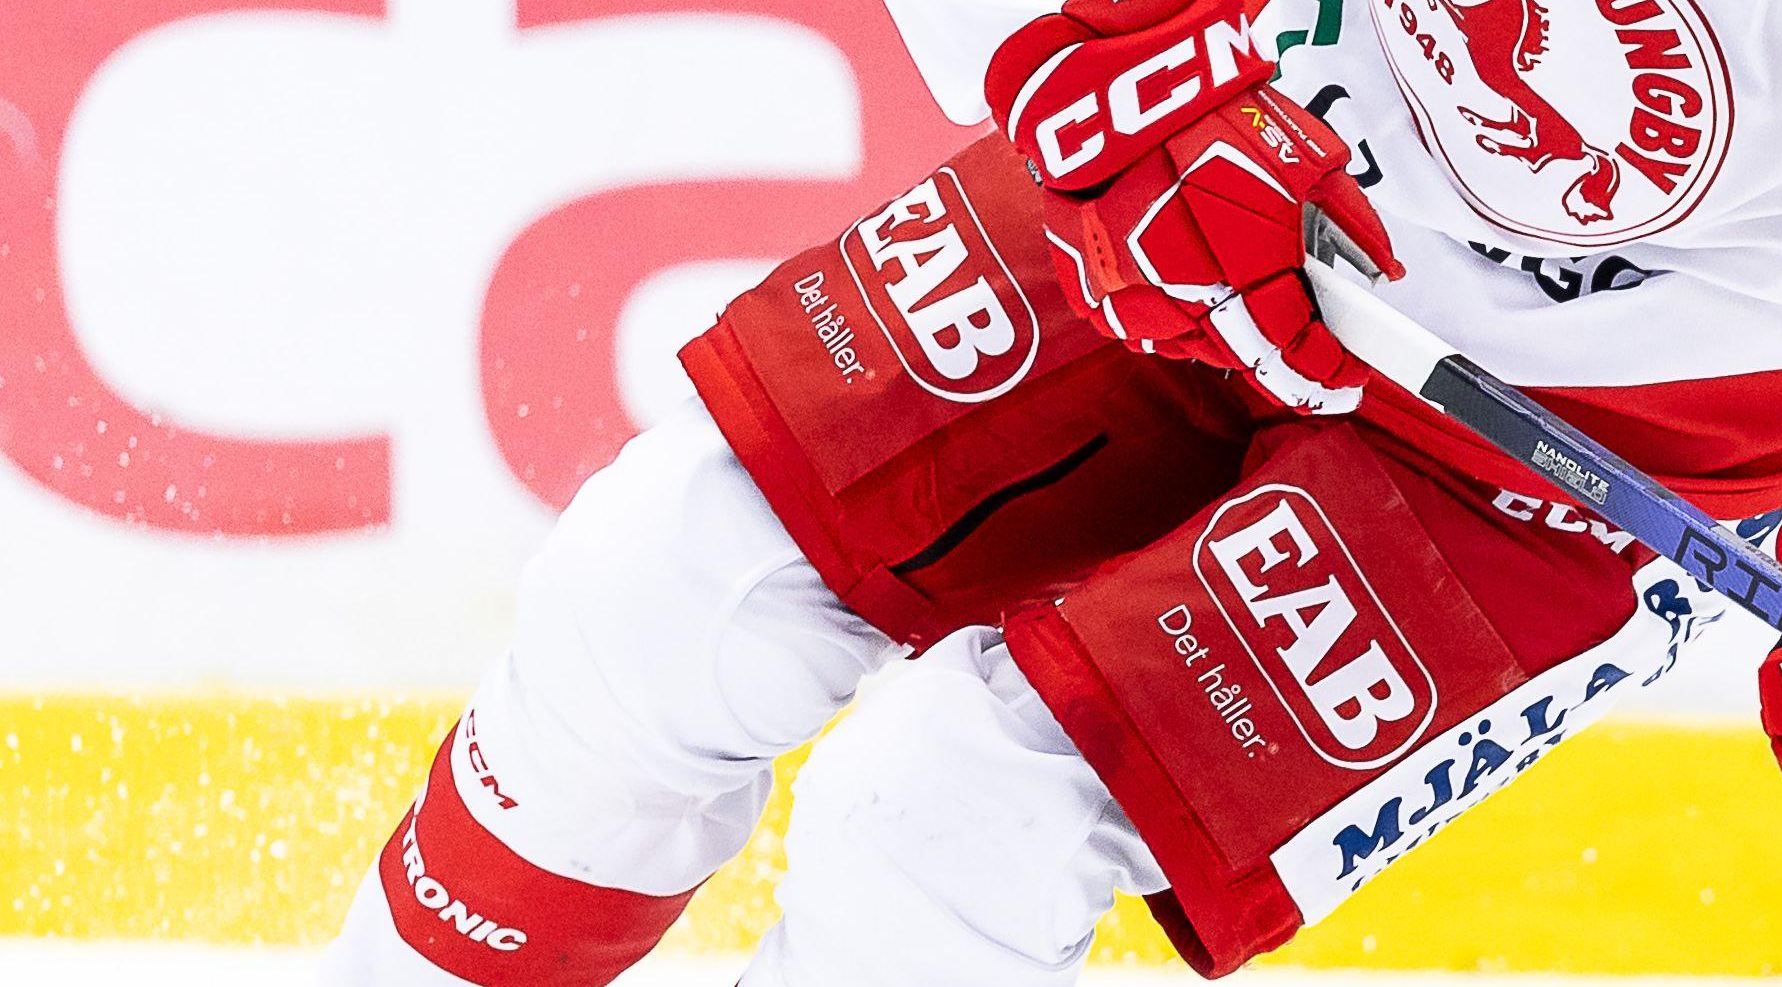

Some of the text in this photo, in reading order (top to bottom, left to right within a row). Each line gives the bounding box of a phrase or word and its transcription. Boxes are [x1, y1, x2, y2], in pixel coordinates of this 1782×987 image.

[1035, 14, 1262, 181] CCM
[794, 271, 865, 384] Det håller.
[857, 178, 1016, 380] EAB
[1536, 440, 1610, 492] NANOLITE
[1157, 604, 1266, 758] Det håller.
[1207, 498, 1416, 750] EAB
